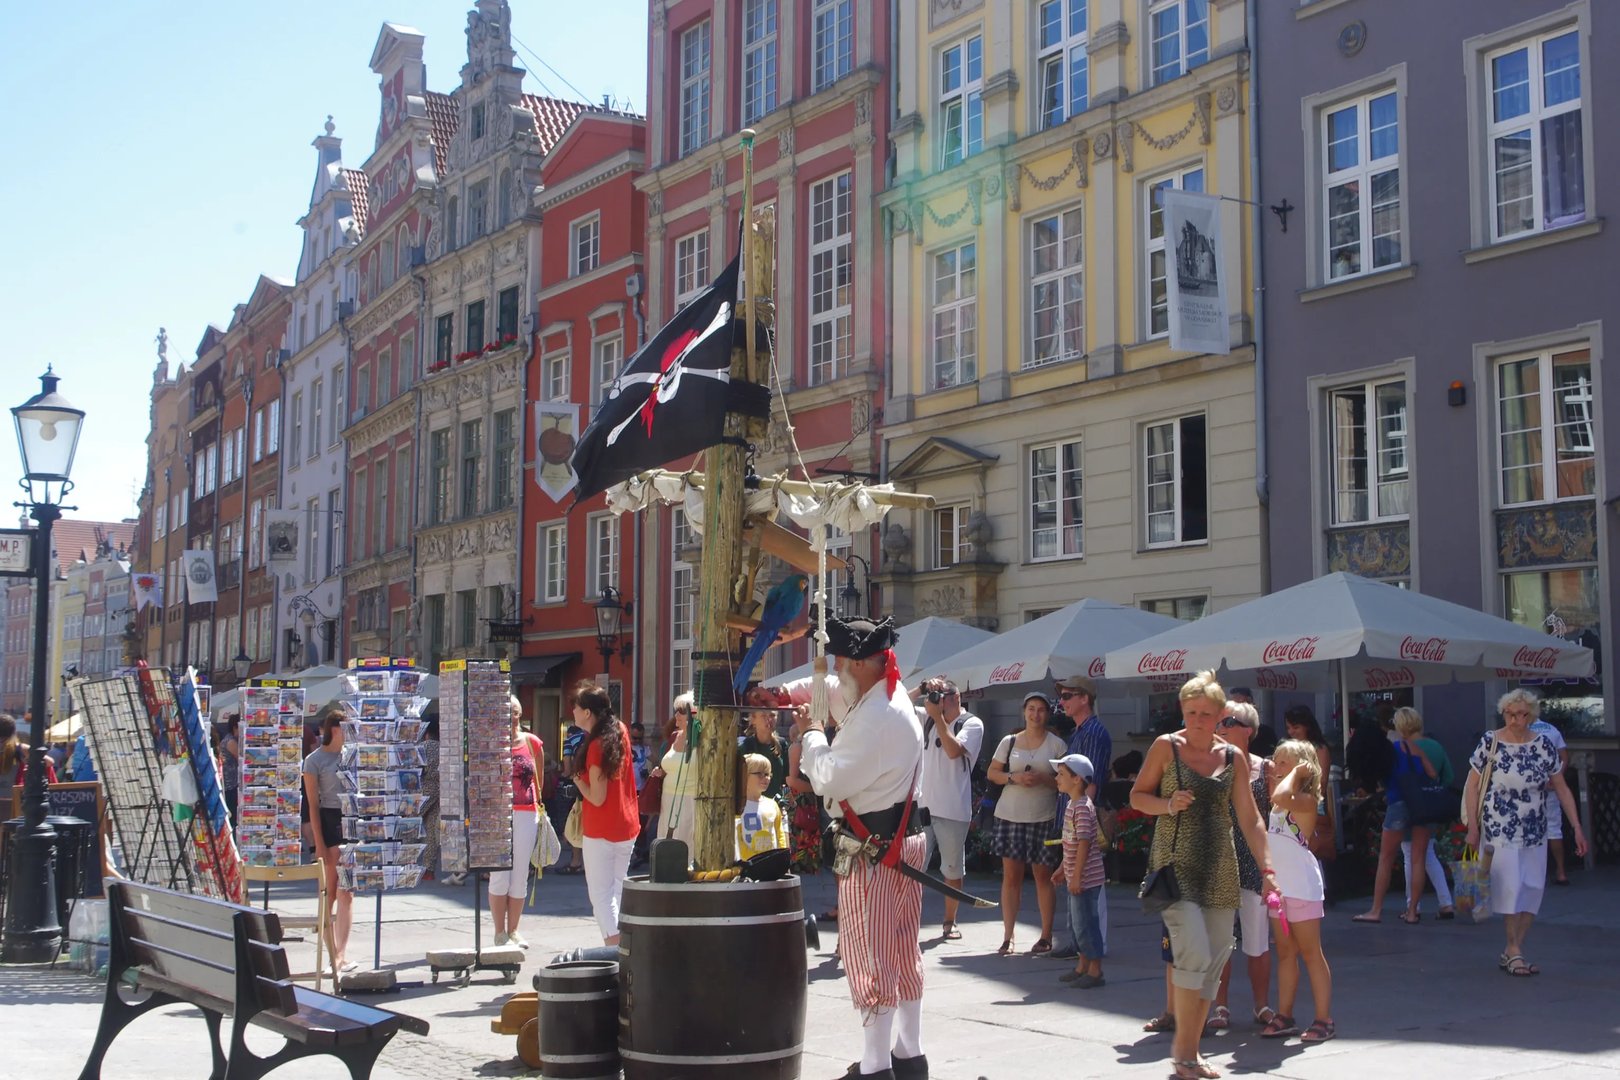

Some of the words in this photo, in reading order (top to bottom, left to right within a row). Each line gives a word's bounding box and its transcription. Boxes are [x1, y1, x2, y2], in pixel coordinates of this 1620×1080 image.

[1138, 649, 1188, 673] Coca-Cola
[1263, 636, 1319, 664] Coca-Cola
[1400, 635, 1448, 661] Coca-Cola
